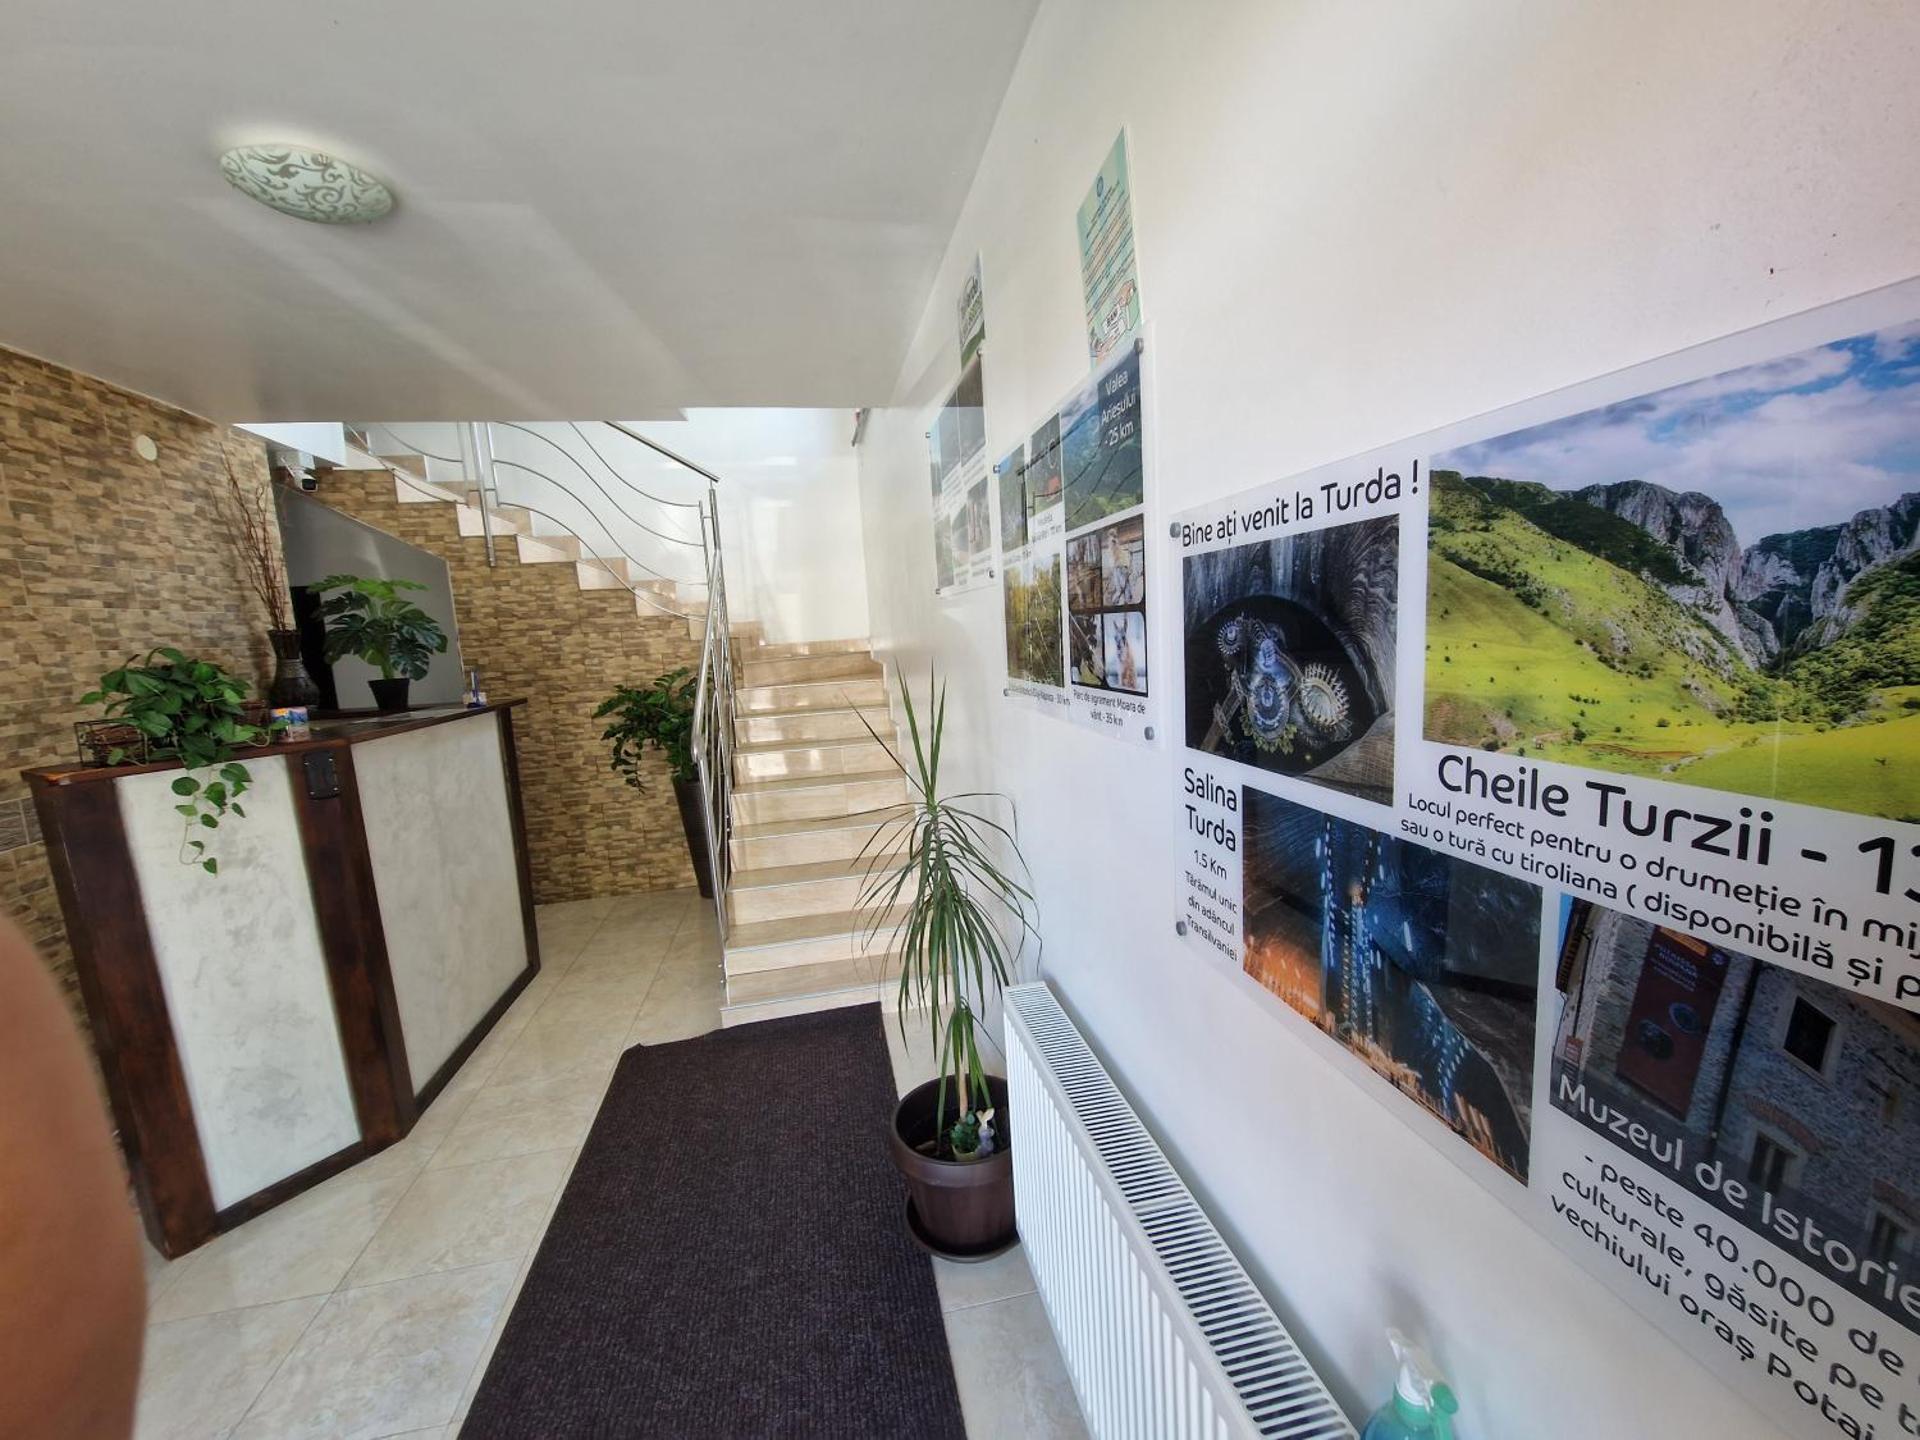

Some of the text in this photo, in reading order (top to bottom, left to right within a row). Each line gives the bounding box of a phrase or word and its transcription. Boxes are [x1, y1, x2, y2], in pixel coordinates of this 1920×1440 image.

[1109, 425, 1119, 446] 25
[1120, 420, 1134, 439] km
[1182, 522, 1213, 548] Bine
[1216, 510, 1237, 544] ați
[1241, 496, 1290, 533] venit
[1295, 491, 1313, 521] la
[1321, 467, 1401, 513] Turda
[1136, 702, 1146, 715] de
[1184, 767, 1237, 812] Salina
[1438, 754, 1569, 817] Cheile
[1585, 780, 1774, 866] Turzii
[1801, 848, 1828, 862] -
[1185, 804, 1236, 852] Turda
[1194, 849, 1228, 881] 1.5 Km
[1408, 793, 1920, 960] Locul perfect pentru o drumeție în mi
[1188, 895, 1200, 912] din
[1219, 895, 1238, 915] unic
[1401, 819, 1428, 838] sau
[1433, 829, 1444, 842] o
[1449, 830, 1485, 857] tură
[1492, 847, 1514, 865] cu
[1521, 854, 1617, 899] tiroliana
[1644, 891, 1834, 970] disponibilă
[1847, 957, 1883, 988] și
[1186, 913, 1238, 962] Transilvaniei
[1558, 1074, 1920, 1319] Muzeul de Istorie
[1551, 1194, 1671, 1296] vechiului
[1680, 1293, 1755, 1361] oraș
[1601, 1162, 1685, 1228] peste
[1693, 1222, 1834, 1327] 40.000
[1848, 1328, 1904, 1376] de
[1562, 1171, 1920, 1436] culturale, găsite pe t
